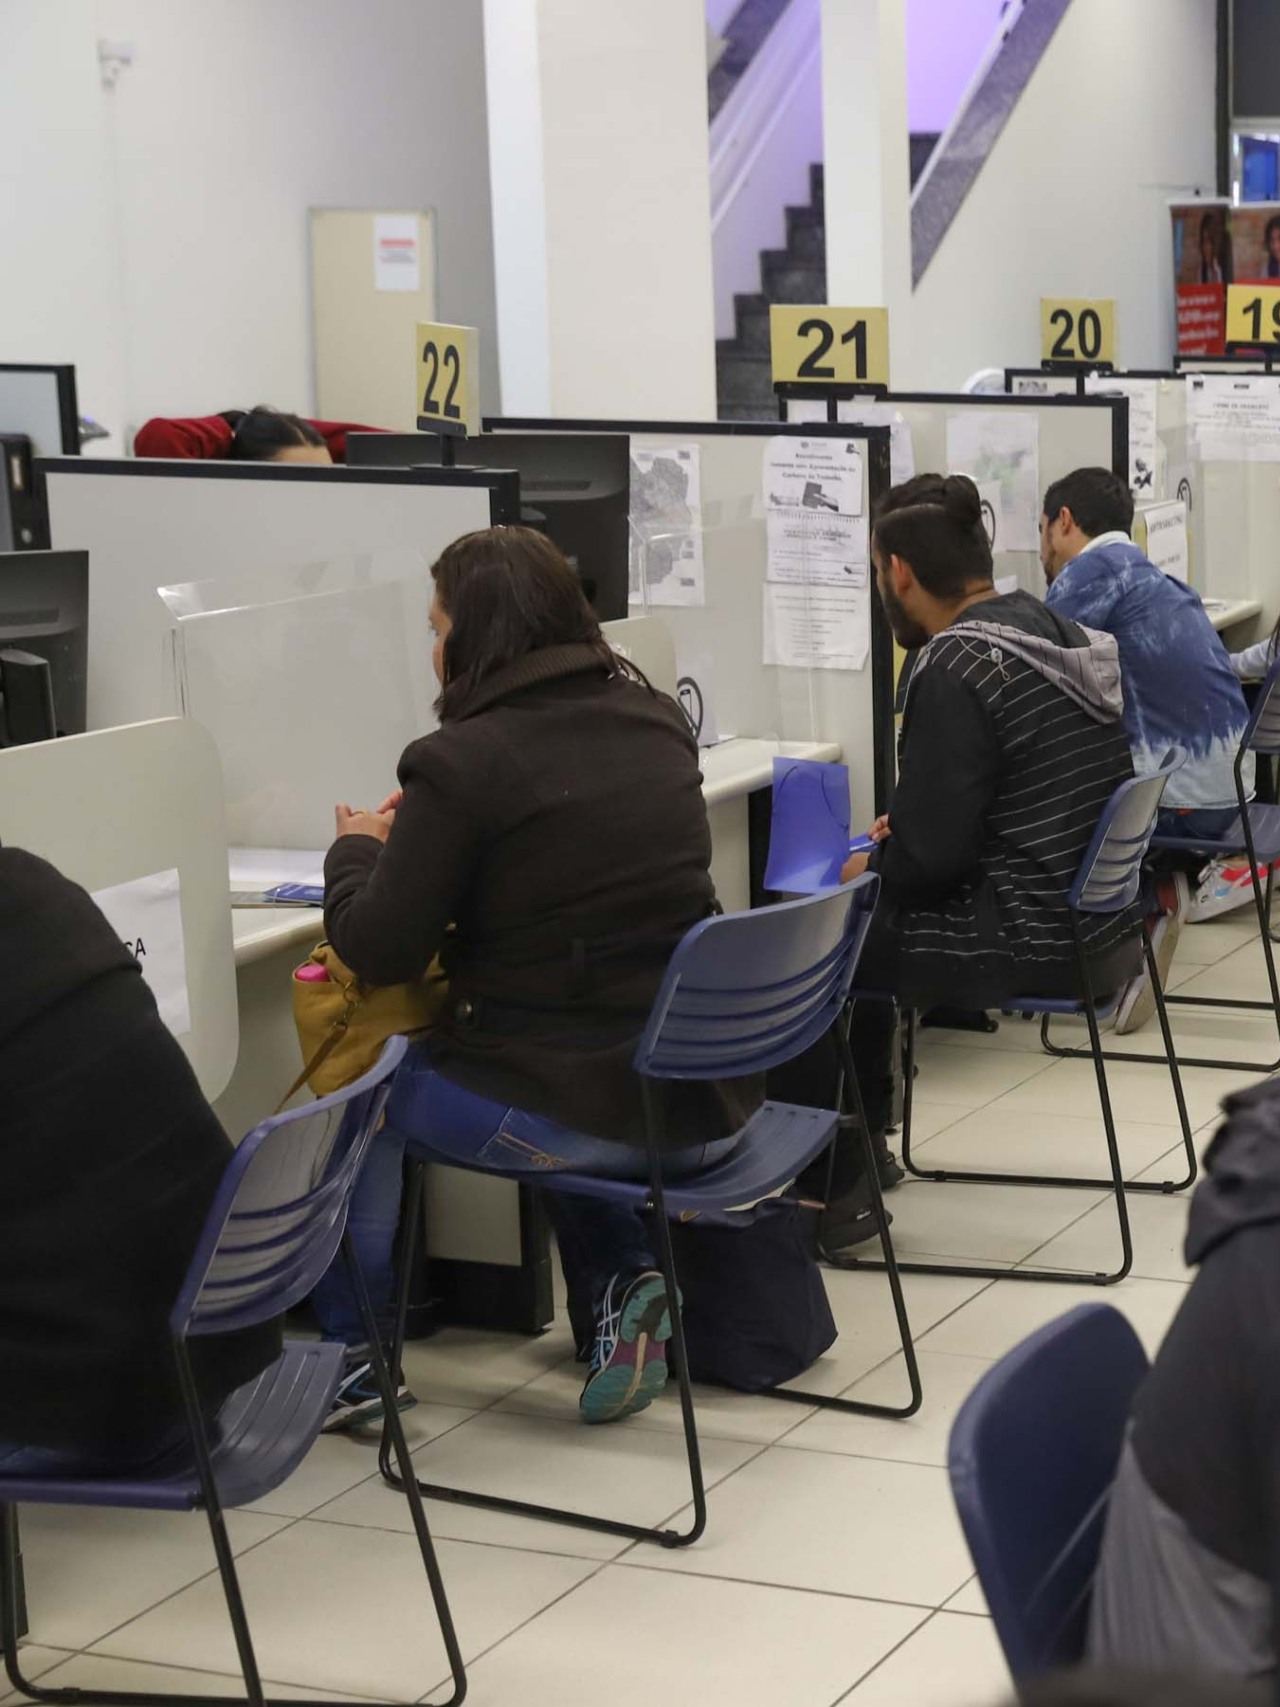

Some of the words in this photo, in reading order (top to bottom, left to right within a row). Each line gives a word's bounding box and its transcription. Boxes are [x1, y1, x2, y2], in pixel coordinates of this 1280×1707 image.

[797, 318, 867, 379] 21
[1049, 308, 1102, 360] 20
[422, 340, 461, 419] 22
